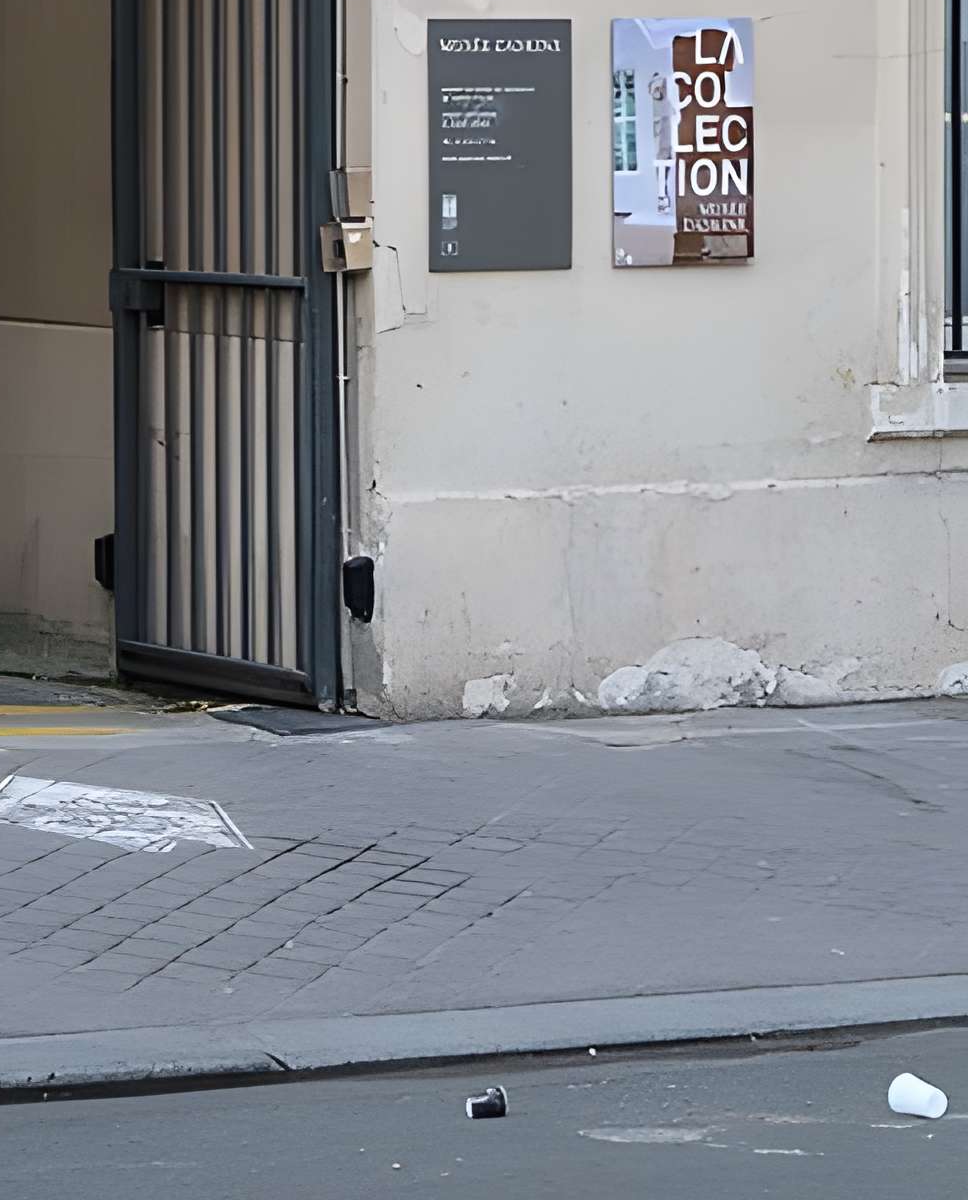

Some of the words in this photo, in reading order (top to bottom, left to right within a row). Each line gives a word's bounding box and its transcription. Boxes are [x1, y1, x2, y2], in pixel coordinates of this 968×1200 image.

[695, 28, 745, 65] LA
[672, 114, 748, 152] LEC
[653, 158, 749, 196] TION
